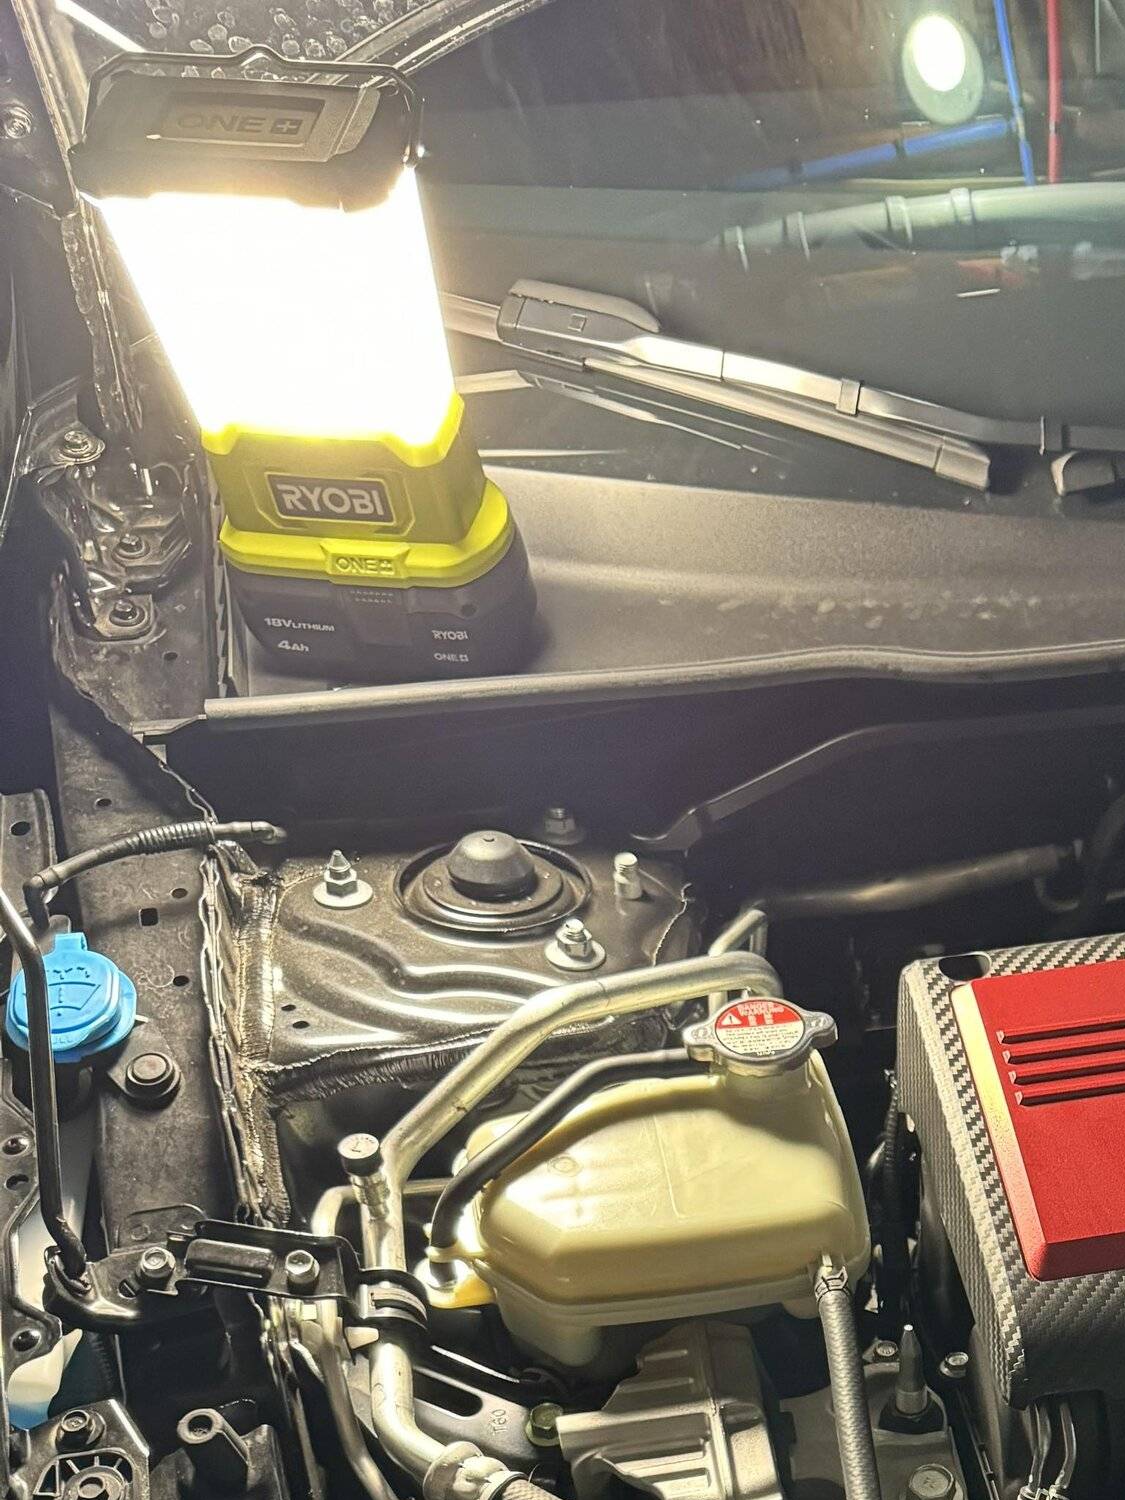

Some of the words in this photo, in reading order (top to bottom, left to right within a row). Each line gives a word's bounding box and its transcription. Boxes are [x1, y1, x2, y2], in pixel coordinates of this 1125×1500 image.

[275, 483, 385, 516] RYOBI
[431, 629, 469, 641] RYOBI
[277, 640, 310, 652] 4Ah
